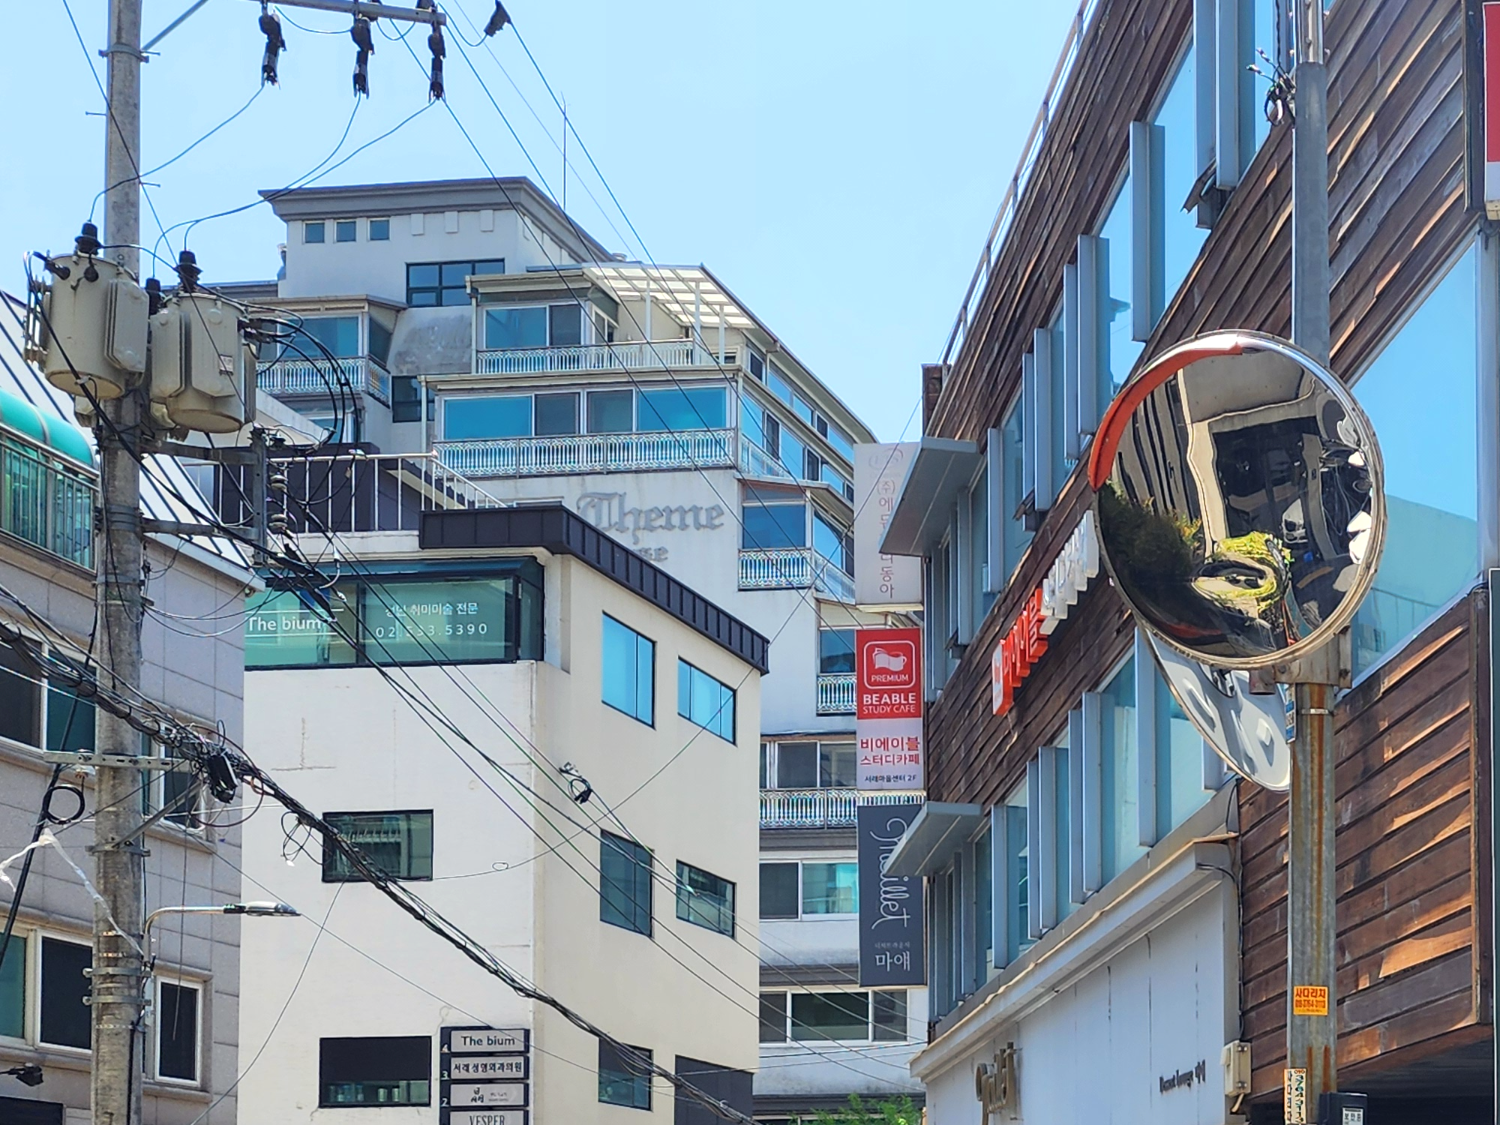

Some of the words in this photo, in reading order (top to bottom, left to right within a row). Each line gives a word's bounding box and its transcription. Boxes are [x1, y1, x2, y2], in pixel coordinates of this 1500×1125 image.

[576, 492, 725, 545] Theme
[456, 602, 478, 614] 전문
[248, 617, 277, 631] The
[282, 615, 321, 630] bium
[871, 674, 909, 682] PREMIUM
[863, 692, 916, 705] BEABLE
[863, 705, 892, 714] STUDY
[893, 704, 916, 713] CAFE
[860, 736, 920, 752] 비에이블
[860, 753, 920, 766] 스터디카페
[461, 1036, 483, 1046] The
[487, 1036, 515, 1046] bium
